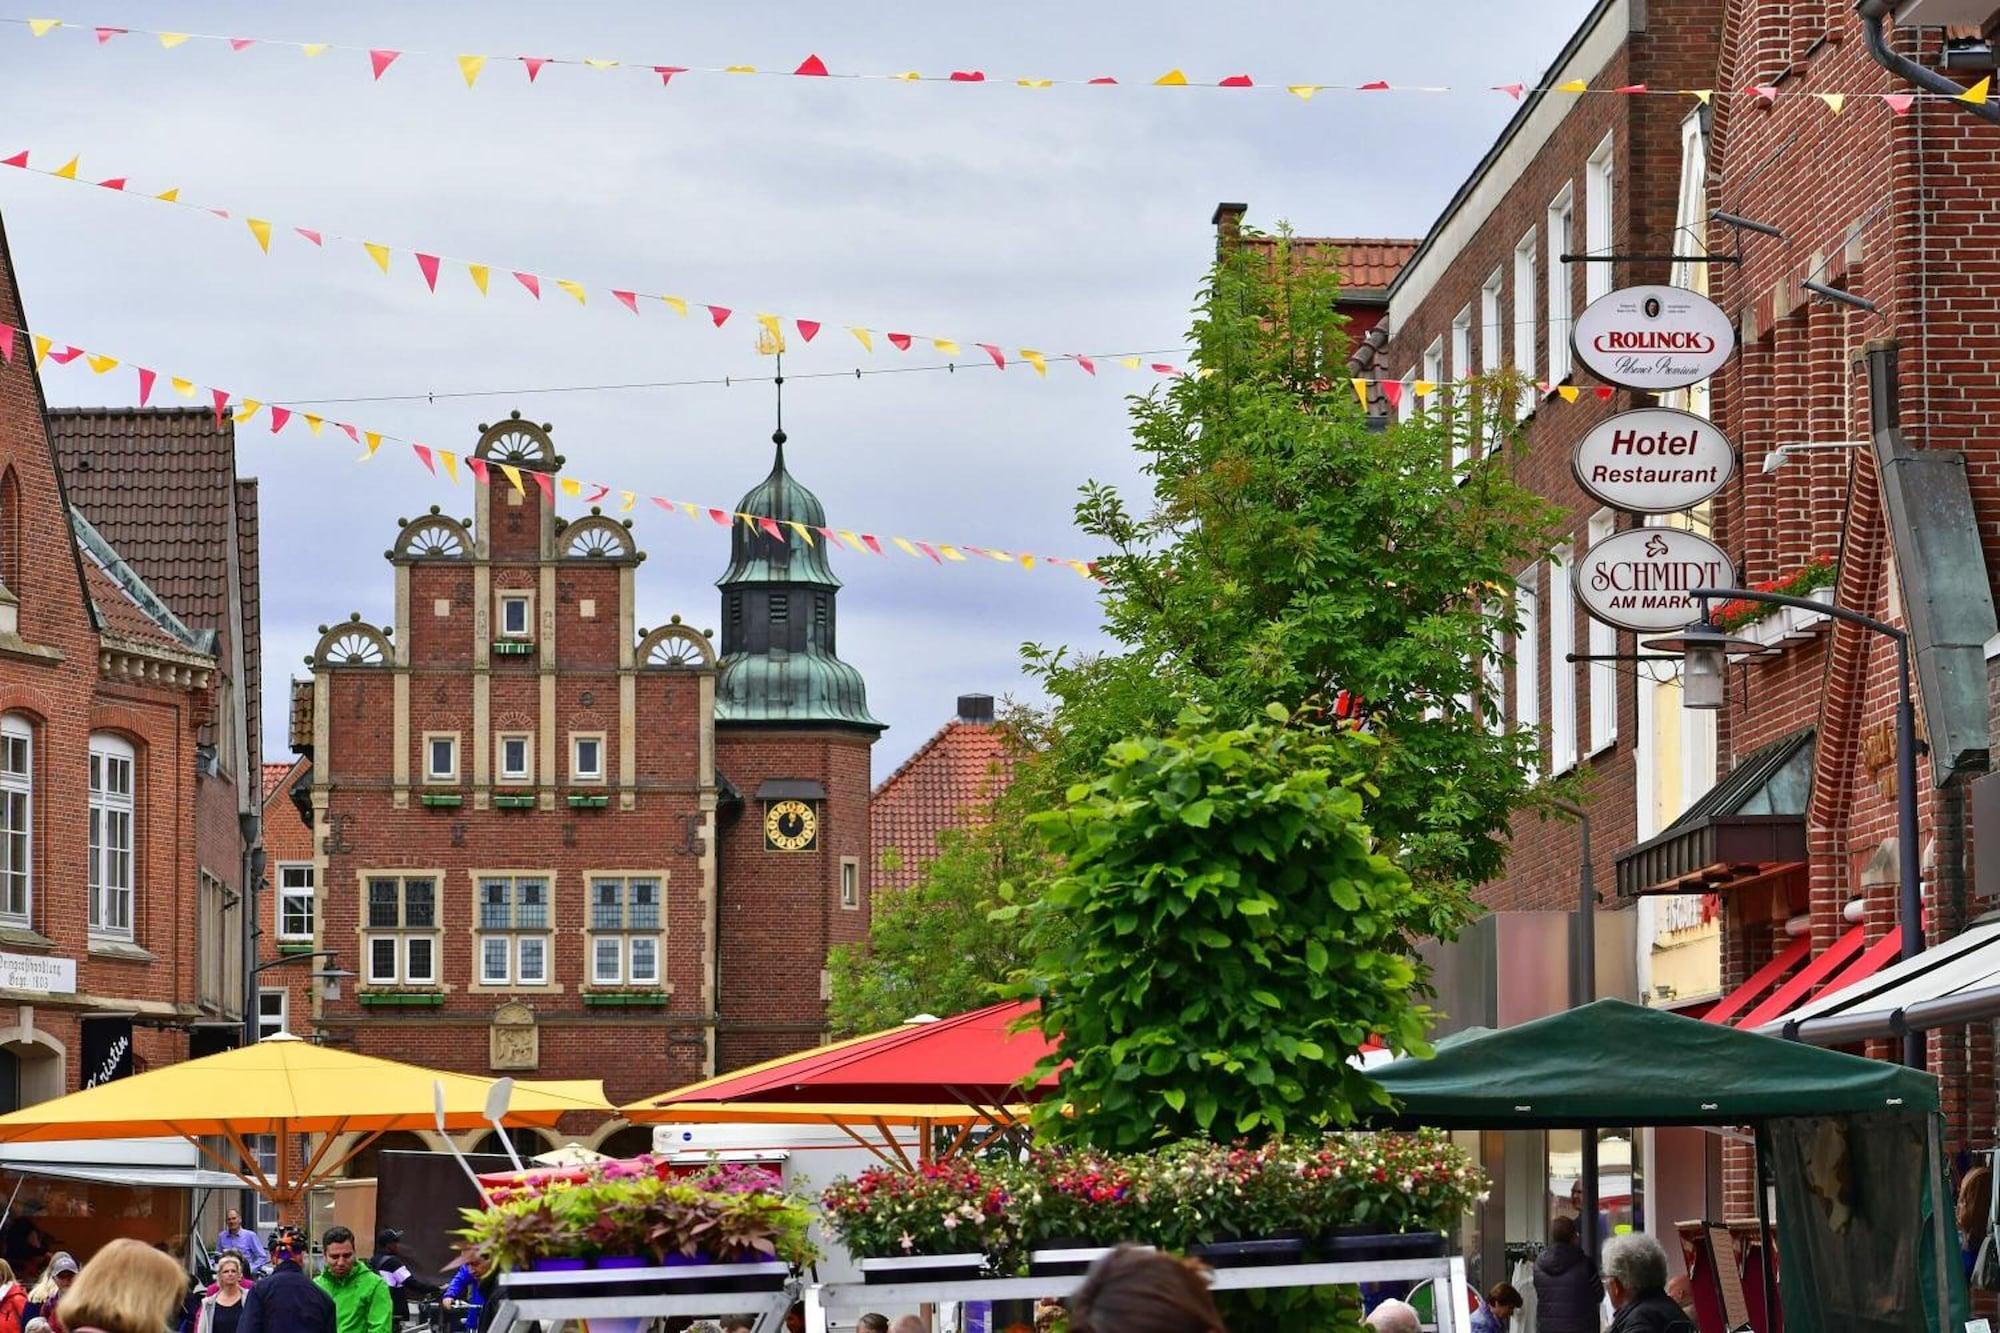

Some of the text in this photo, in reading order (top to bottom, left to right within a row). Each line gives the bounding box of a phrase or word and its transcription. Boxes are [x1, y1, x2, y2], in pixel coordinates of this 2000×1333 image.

[1608, 331, 1702, 349] ROLINCK
[1655, 355, 1700, 375] Premium
[1611, 430, 1698, 456] Hotel
[1592, 465, 1718, 483] Restaurant
[1591, 560, 1721, 592] SCHMIDT
[1609, 595, 1637, 609] AM
